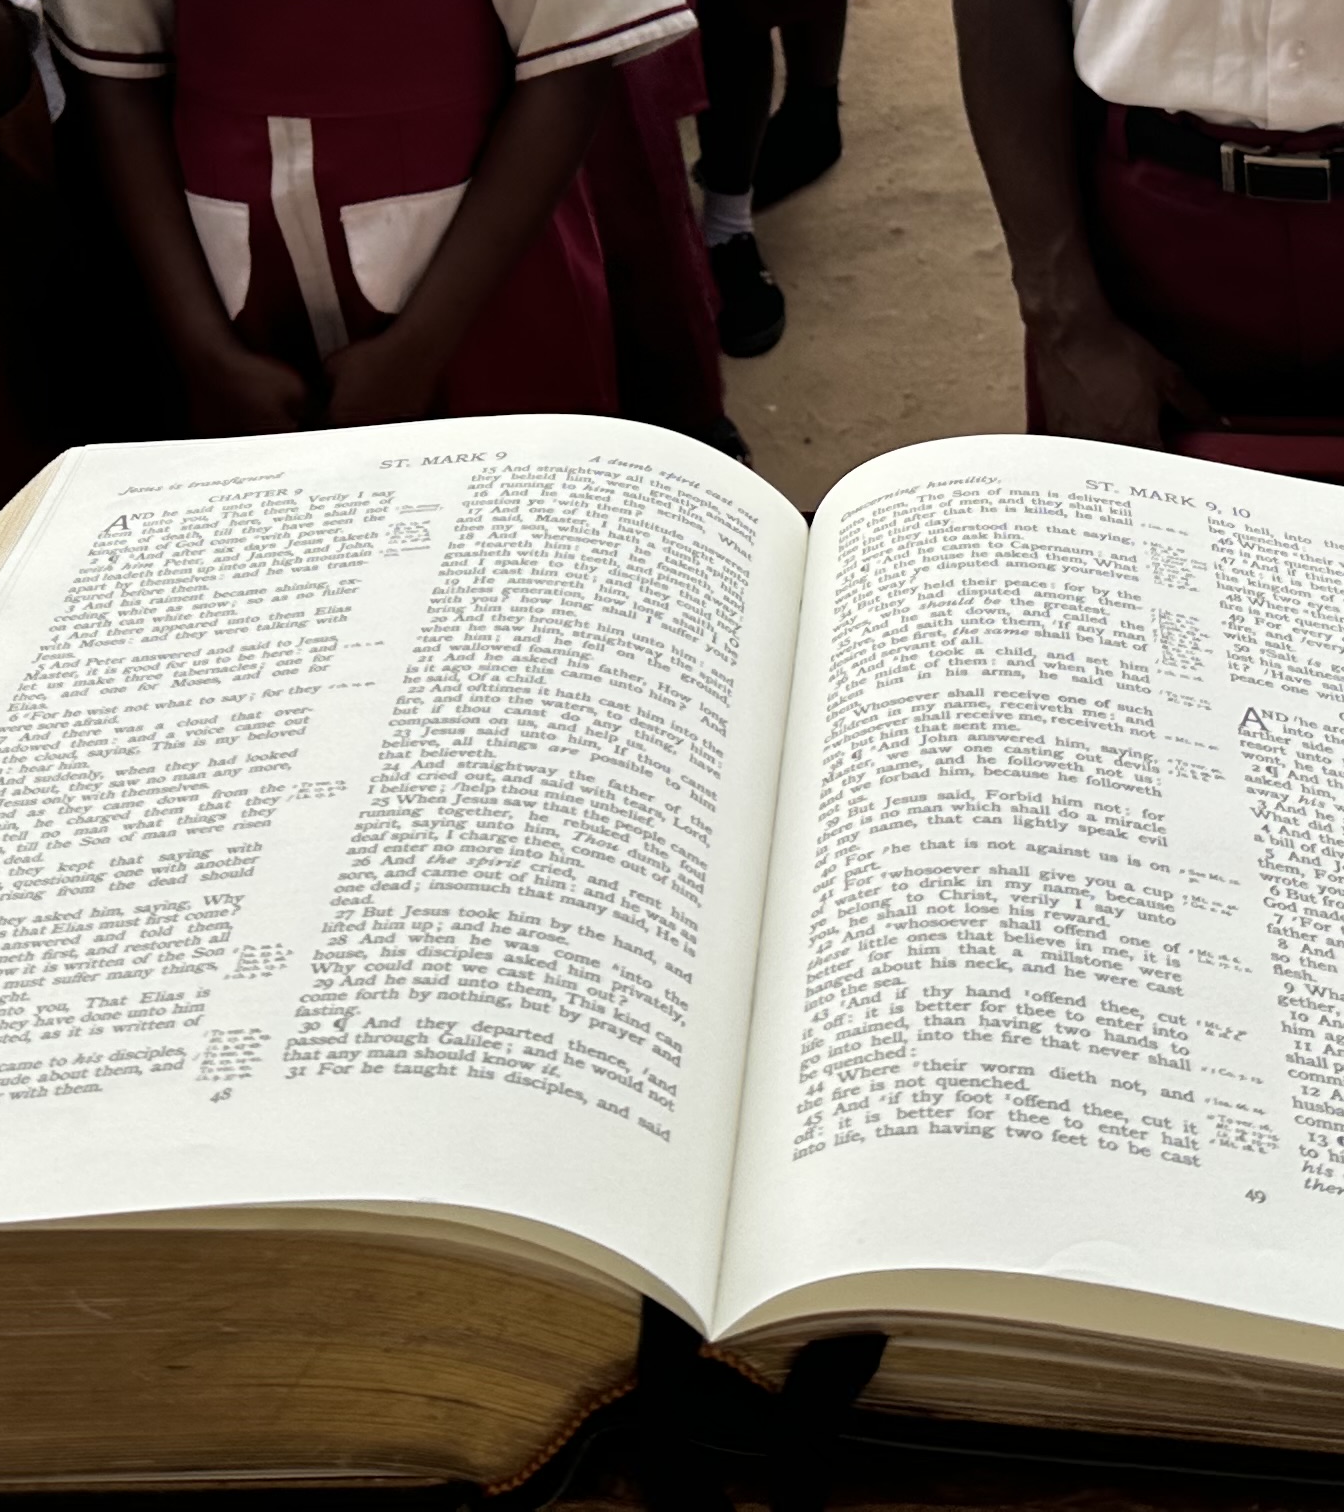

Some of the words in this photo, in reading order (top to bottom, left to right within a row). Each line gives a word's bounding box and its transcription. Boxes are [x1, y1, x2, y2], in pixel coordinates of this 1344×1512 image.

[379, 459, 411, 470] ST.
[422, 452, 486, 466] MARK
[495, 451, 508, 461] 9
[118, 486, 164, 496] Jesus
[168, 483, 183, 491] is
[187, 471, 286, 489] transfigured
[589, 455, 601, 463] A
[607, 458, 653, 472] dumb
[658, 470, 701, 489] spirit
[705, 489, 733, 506] cast
[737, 507, 759, 524] out
[208, 489, 289, 503] CHAPTER
[294, 488, 304, 497] 9
[1086, 480, 1119, 494] ST.
[1130, 487, 1194, 507] MARK
[1206, 502, 1221, 514] 9,
[1233, 507, 1250, 518] 10
[31, 653, 75, 664] Jesus.
[403, 675, 421, 684] he
[426, 673, 460, 683] said,
[468, 672, 489, 681] Of
[506, 674, 546, 684] child.
[1230, 673, 1273, 688] peace
[1281, 684, 1309, 695] one
[6, 702, 48, 712] Elias.
[37, 721, 70, 730] sore
[72, 715, 119, 727] afraid.
[378, 750, 412, 760] that
[420, 748, 497, 758] believeth.
[3, 852, 44, 865] dead.
[346, 843, 378, 855] and
[383, 843, 429, 853] enter
[433, 844, 455, 852] no
[459, 845, 505, 854] more
[510, 847, 543, 859] into
[549, 848, 585, 868] him.
[329, 894, 374, 906] dead.
[321, 920, 366, 933] lifted
[371, 919, 405, 930] him
[450, 921, 485, 932] and
[490, 922, 512, 934] he
[516, 928, 569, 946] arose.
[1273, 964, 1317, 982] flesh.
[804, 993, 835, 1012] into
[841, 983, 868, 997] the
[873, 977, 906, 988] sea.
[294, 1004, 361, 1021] fasting.
[1278, 995, 1340, 1017] gether,
[40, 1030, 61, 1040] as
[67, 1026, 82, 1037] it
[88, 1024, 104, 1035] is
[112, 1020, 176, 1033] written
[183, 1014, 205, 1027] of
[1281, 1021, 1315, 1038] him
[283, 1049, 322, 1062] that
[326, 1050, 360, 1062] any
[366, 1049, 408, 1058] man
[413, 1047, 476, 1062] should
[481, 1052, 536, 1071] know
[541, 1064, 560, 1078] it.
[799, 1068, 818, 1084] be
[822, 1045, 916, 1077] quenched:
[9, 1086, 49, 1100] with
[54, 1083, 103, 1096] them.
[210, 1087, 232, 1103] 48
[797, 1097, 823, 1114] the
[832, 1086, 861, 1101] fire
[870, 1079, 885, 1092] is
[895, 1076, 926, 1089] not
[935, 1076, 1031, 1091] quenched.
[285, 1066, 307, 1079] 31
[317, 1062, 354, 1075] For
[360, 1061, 384, 1074] he
[393, 1063, 458, 1078] taught
[467, 1065, 495, 1080] his
[504, 1071, 588, 1105] disciples,
[596, 1099, 630, 1119] and
[638, 1117, 671, 1143] said
[792, 1142, 826, 1161] into
[834, 1130, 866, 1146] life,
[875, 1124, 919, 1138] than
[929, 1121, 996, 1139] having
[1005, 1125, 1043, 1140] two
[1052, 1129, 1088, 1146] feet
[1098, 1137, 1119, 1151] to
[1127, 1141, 1151, 1157] be
[1160, 1151, 1201, 1168] cast
[1301, 1160, 1334, 1178] his
[1244, 1188, 1267, 1204] 49
